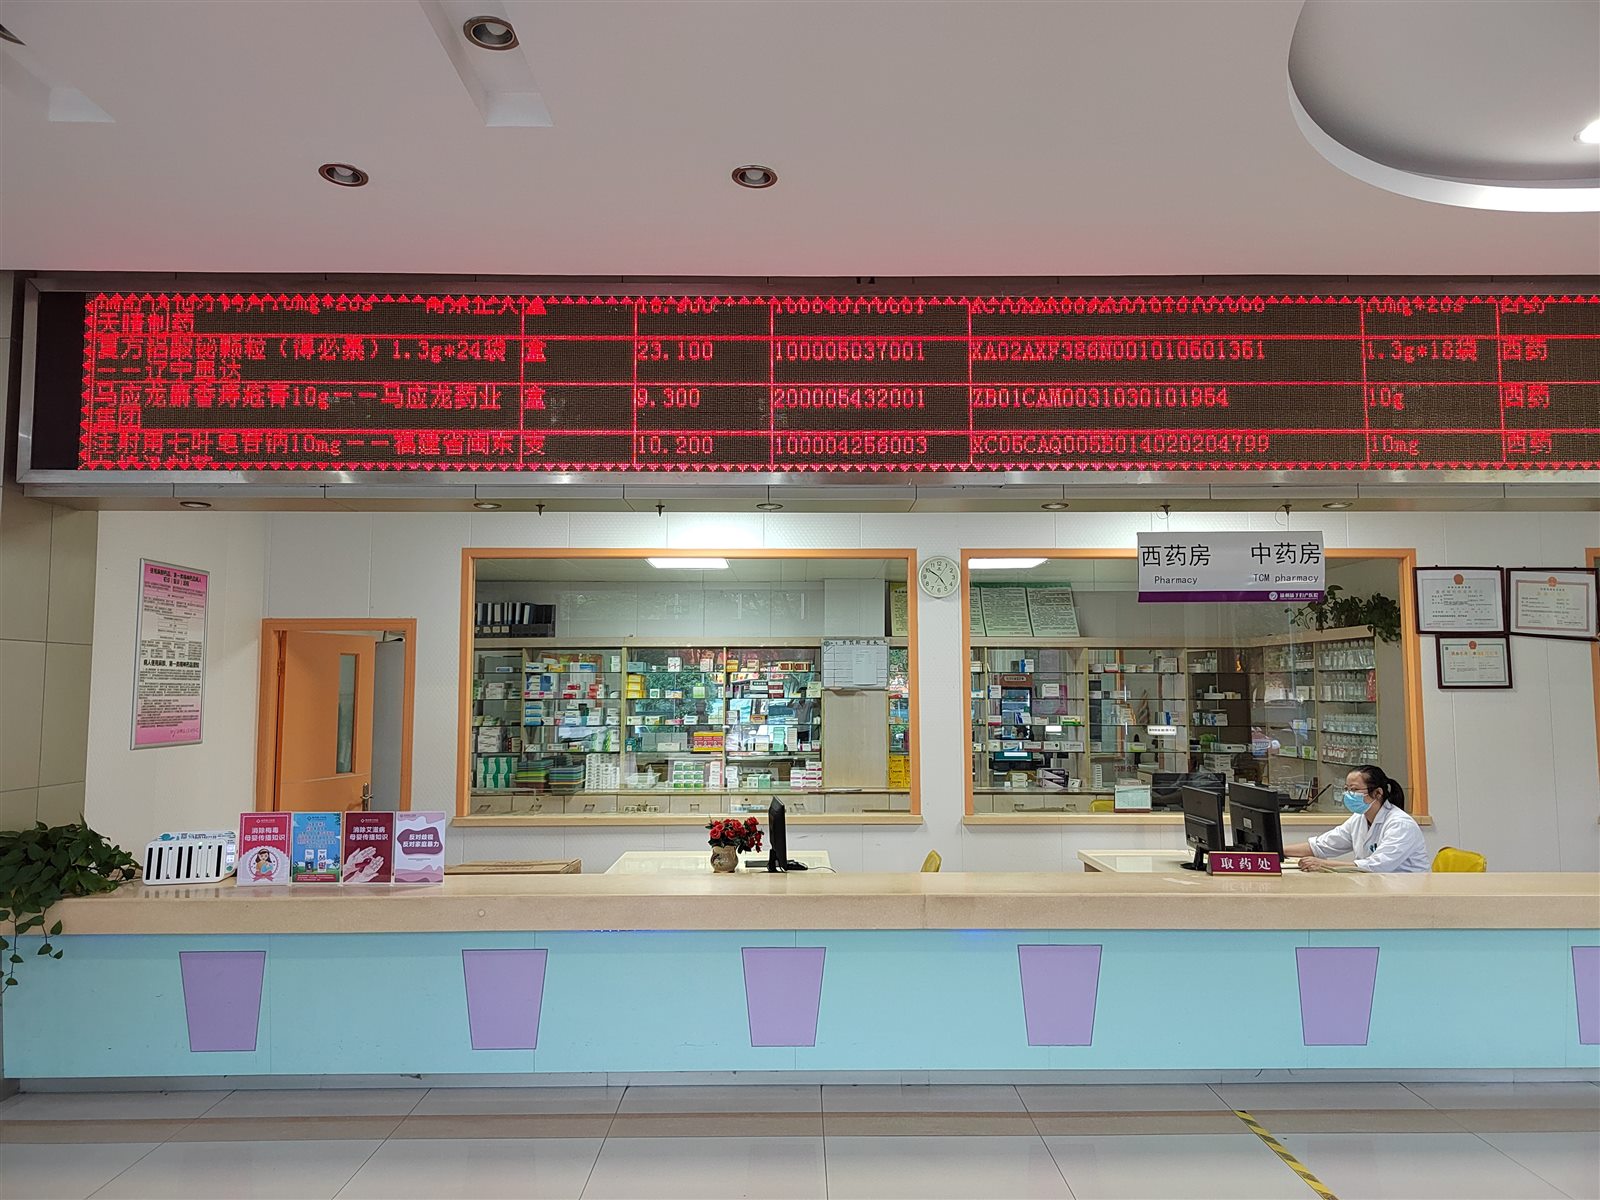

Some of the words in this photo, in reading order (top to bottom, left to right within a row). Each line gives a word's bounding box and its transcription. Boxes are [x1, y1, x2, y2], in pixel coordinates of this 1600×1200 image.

[637, 341, 713, 361] 23.100
[1503, 338, 1548, 361] 西药
[524, 385, 546, 410] 盒
[637, 387, 700, 408] 9.300
[1369, 387, 1405, 410] 10g
[1505, 384, 1549, 408] 西药
[638, 436, 713, 455] 10.200
[1370, 434, 1420, 456] 10mg
[1507, 432, 1552, 454] 西药
[1140, 543, 1212, 567] 西药房
[1250, 541, 1322, 566] 中药房
[1154, 575, 1198, 585] Pharmacy
[1253, 573, 1270, 583] TCM
[1274, 574, 1319, 584] pharmacy
[349, 833, 388, 841] 母婴传播知识
[1219, 856, 1271, 871] 取药处
